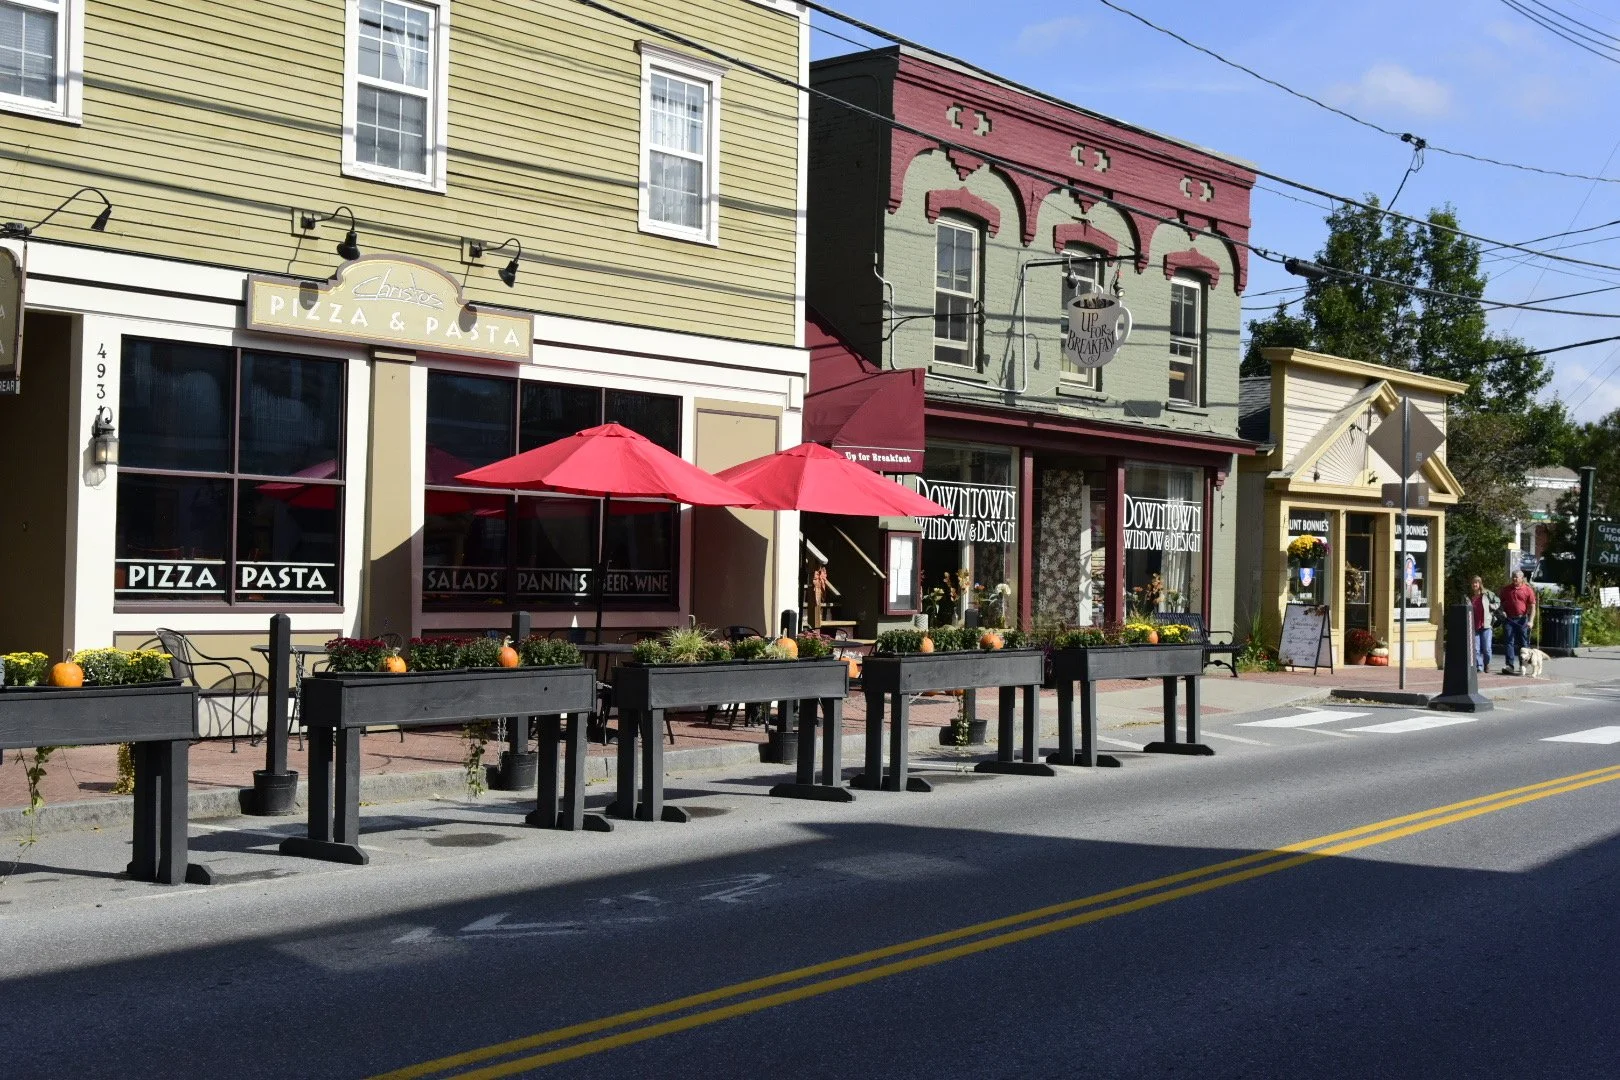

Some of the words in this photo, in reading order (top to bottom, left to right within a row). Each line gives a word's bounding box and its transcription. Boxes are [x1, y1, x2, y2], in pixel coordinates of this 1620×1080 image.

[270, 294, 369, 328] PIZZA
[389, 311, 405, 331] &
[426, 316, 520, 348] PASTA
[1081, 311, 1099, 333] UP
[1090, 324, 1108, 339] FOR
[1067, 329, 1115, 356] BREAKFAST
[845, 451, 857, 463] Up
[858, 452, 871, 461] for
[872, 453, 912, 463] Breakfast
[1123, 493, 1202, 532] DOWNTOWN
[915, 516, 969, 541] WINDOW
[977, 520, 1016, 543] DESIGN
[1289, 519, 1302, 531] UNT
[1123, 529, 1164, 551] WINDOW
[1170, 532, 1201, 552] DESIGN
[128, 564, 218, 588] PIZZA
[241, 566, 327, 590] PASTA
[427, 569, 499, 590] SALADS
[517, 572, 587, 593] PANINIS
